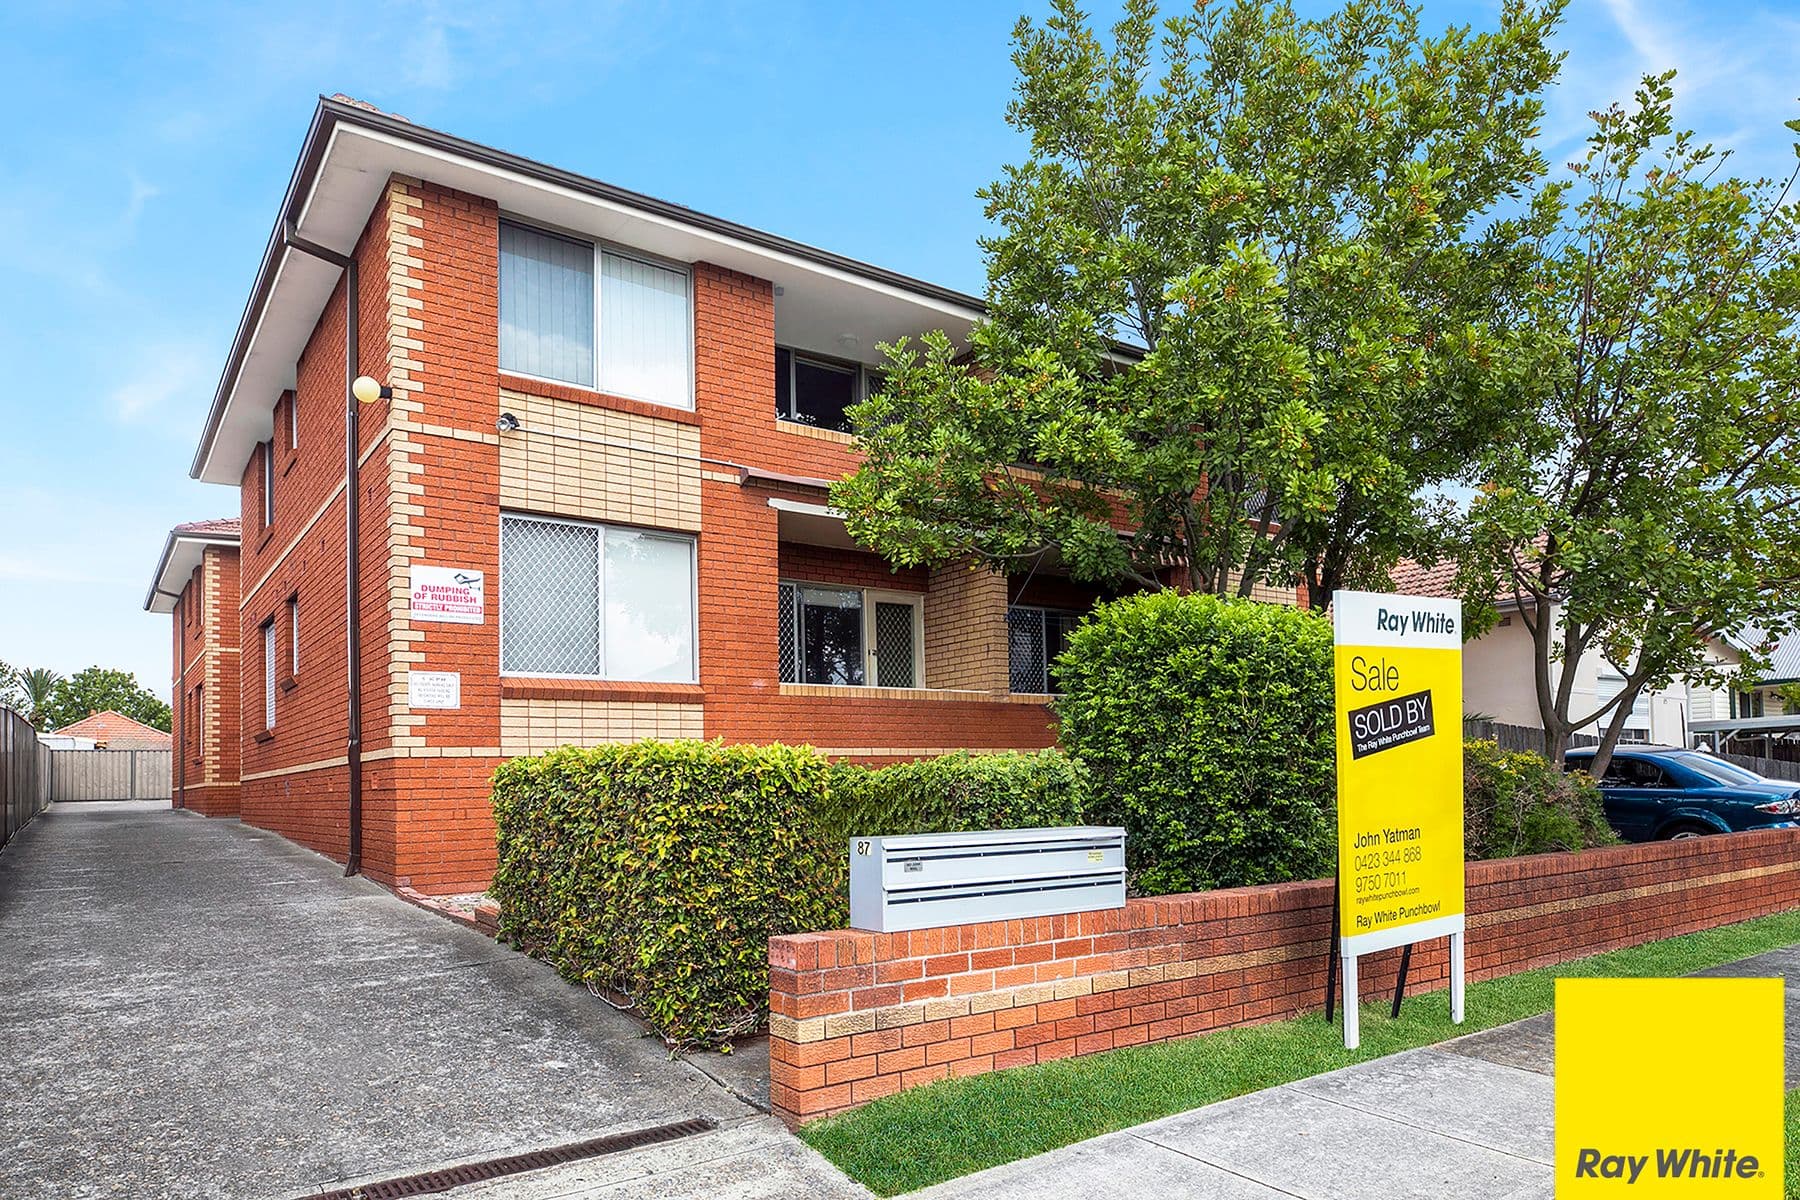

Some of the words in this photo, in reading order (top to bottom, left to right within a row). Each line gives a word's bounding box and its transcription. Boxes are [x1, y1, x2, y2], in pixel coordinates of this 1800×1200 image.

[413, 592, 428, 600] OF
[431, 593, 477, 604] RUBBISH
[421, 585, 470, 595] DUMPING
[1377, 608, 1409, 636] Ray
[1412, 610, 1455, 634] White
[1351, 656, 1399, 691] Sale
[1355, 704, 1402, 739] SOLD
[1406, 696, 1428, 724] BY
[1357, 743, 1368, 752] The
[1368, 740, 1379, 749] Ray
[857, 841, 871, 856] 87
[1354, 832, 1380, 849] John
[1382, 828, 1420, 844] Yatman
[1354, 852, 1380, 872] 0423
[1382, 850, 1401, 867] 344
[1403, 846, 1422, 863] 868
[1355, 873, 1381, 893] 9750
[1383, 871, 1406, 888] 7011
[1356, 887, 1420, 905] raywhitepunchbowl.com
[1356, 914, 1373, 929] Ray
[1374, 910, 1397, 924] White
[1399, 900, 1441, 919] Punchbowl
